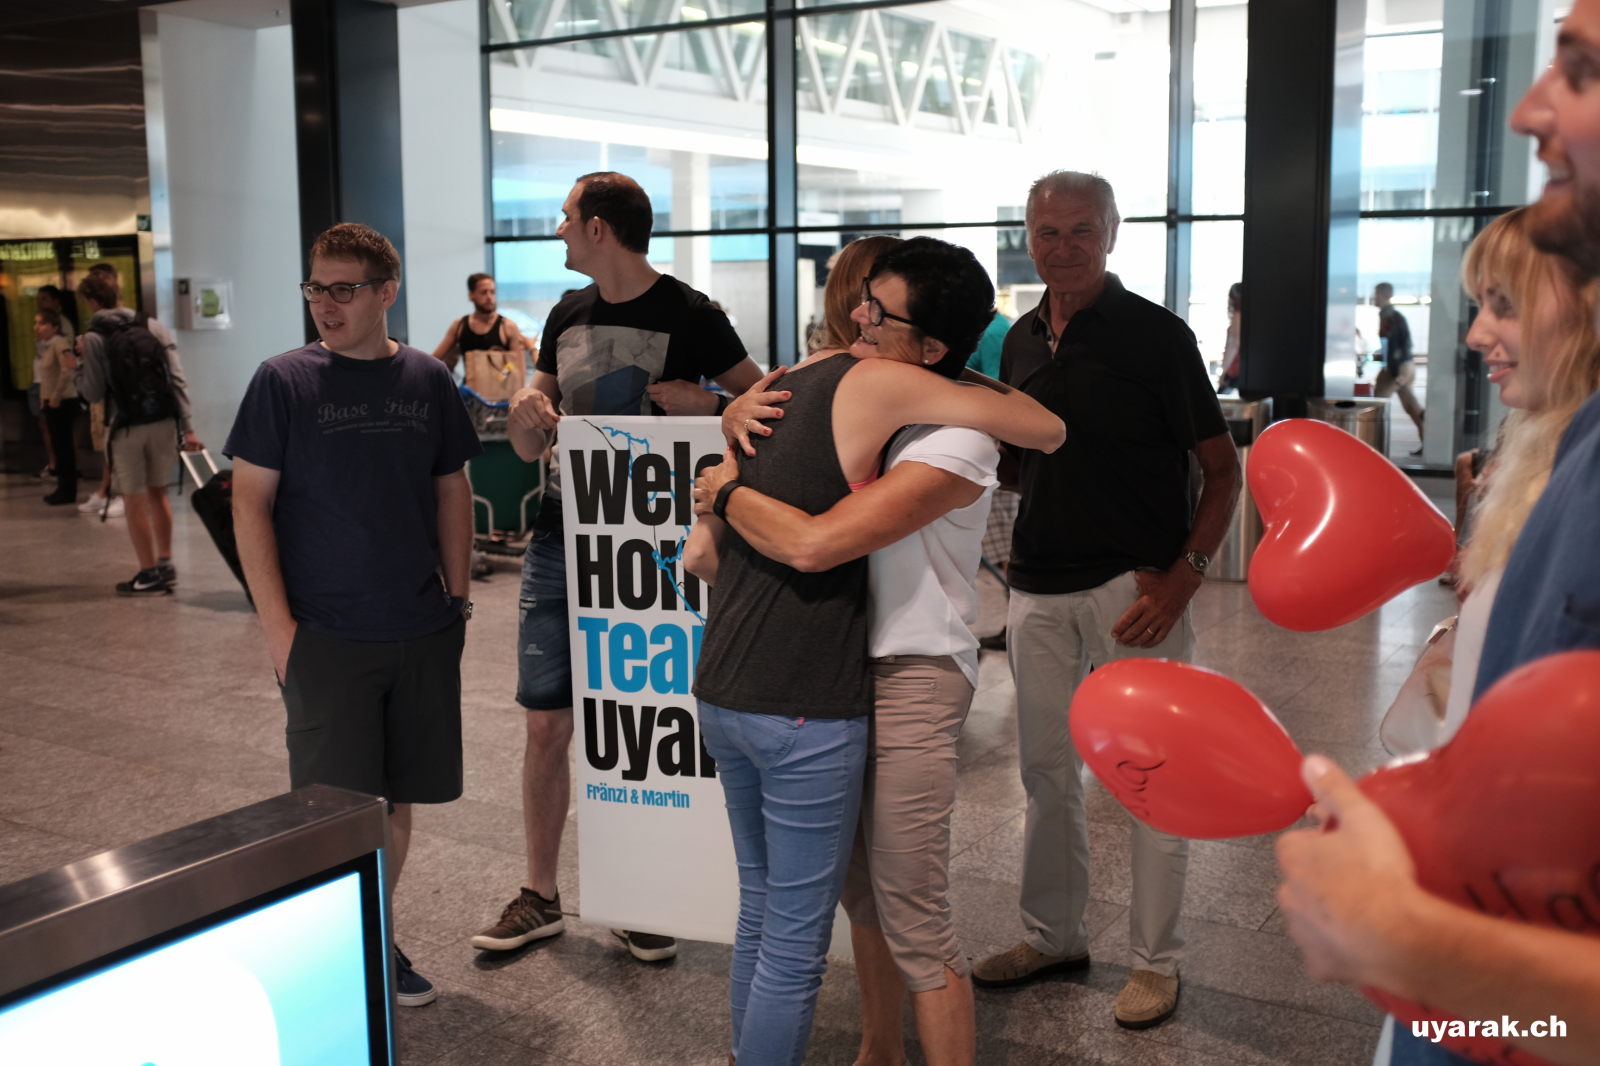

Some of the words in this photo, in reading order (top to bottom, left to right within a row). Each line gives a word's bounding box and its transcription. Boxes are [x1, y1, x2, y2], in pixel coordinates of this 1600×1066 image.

[317, 402, 369, 424] Base
[383, 396, 430, 420] Field
[577, 616, 705, 695] Tea
[586, 782, 628, 803] Fränzi
[630, 788, 639, 805] &
[641, 789, 690, 809] Martin
